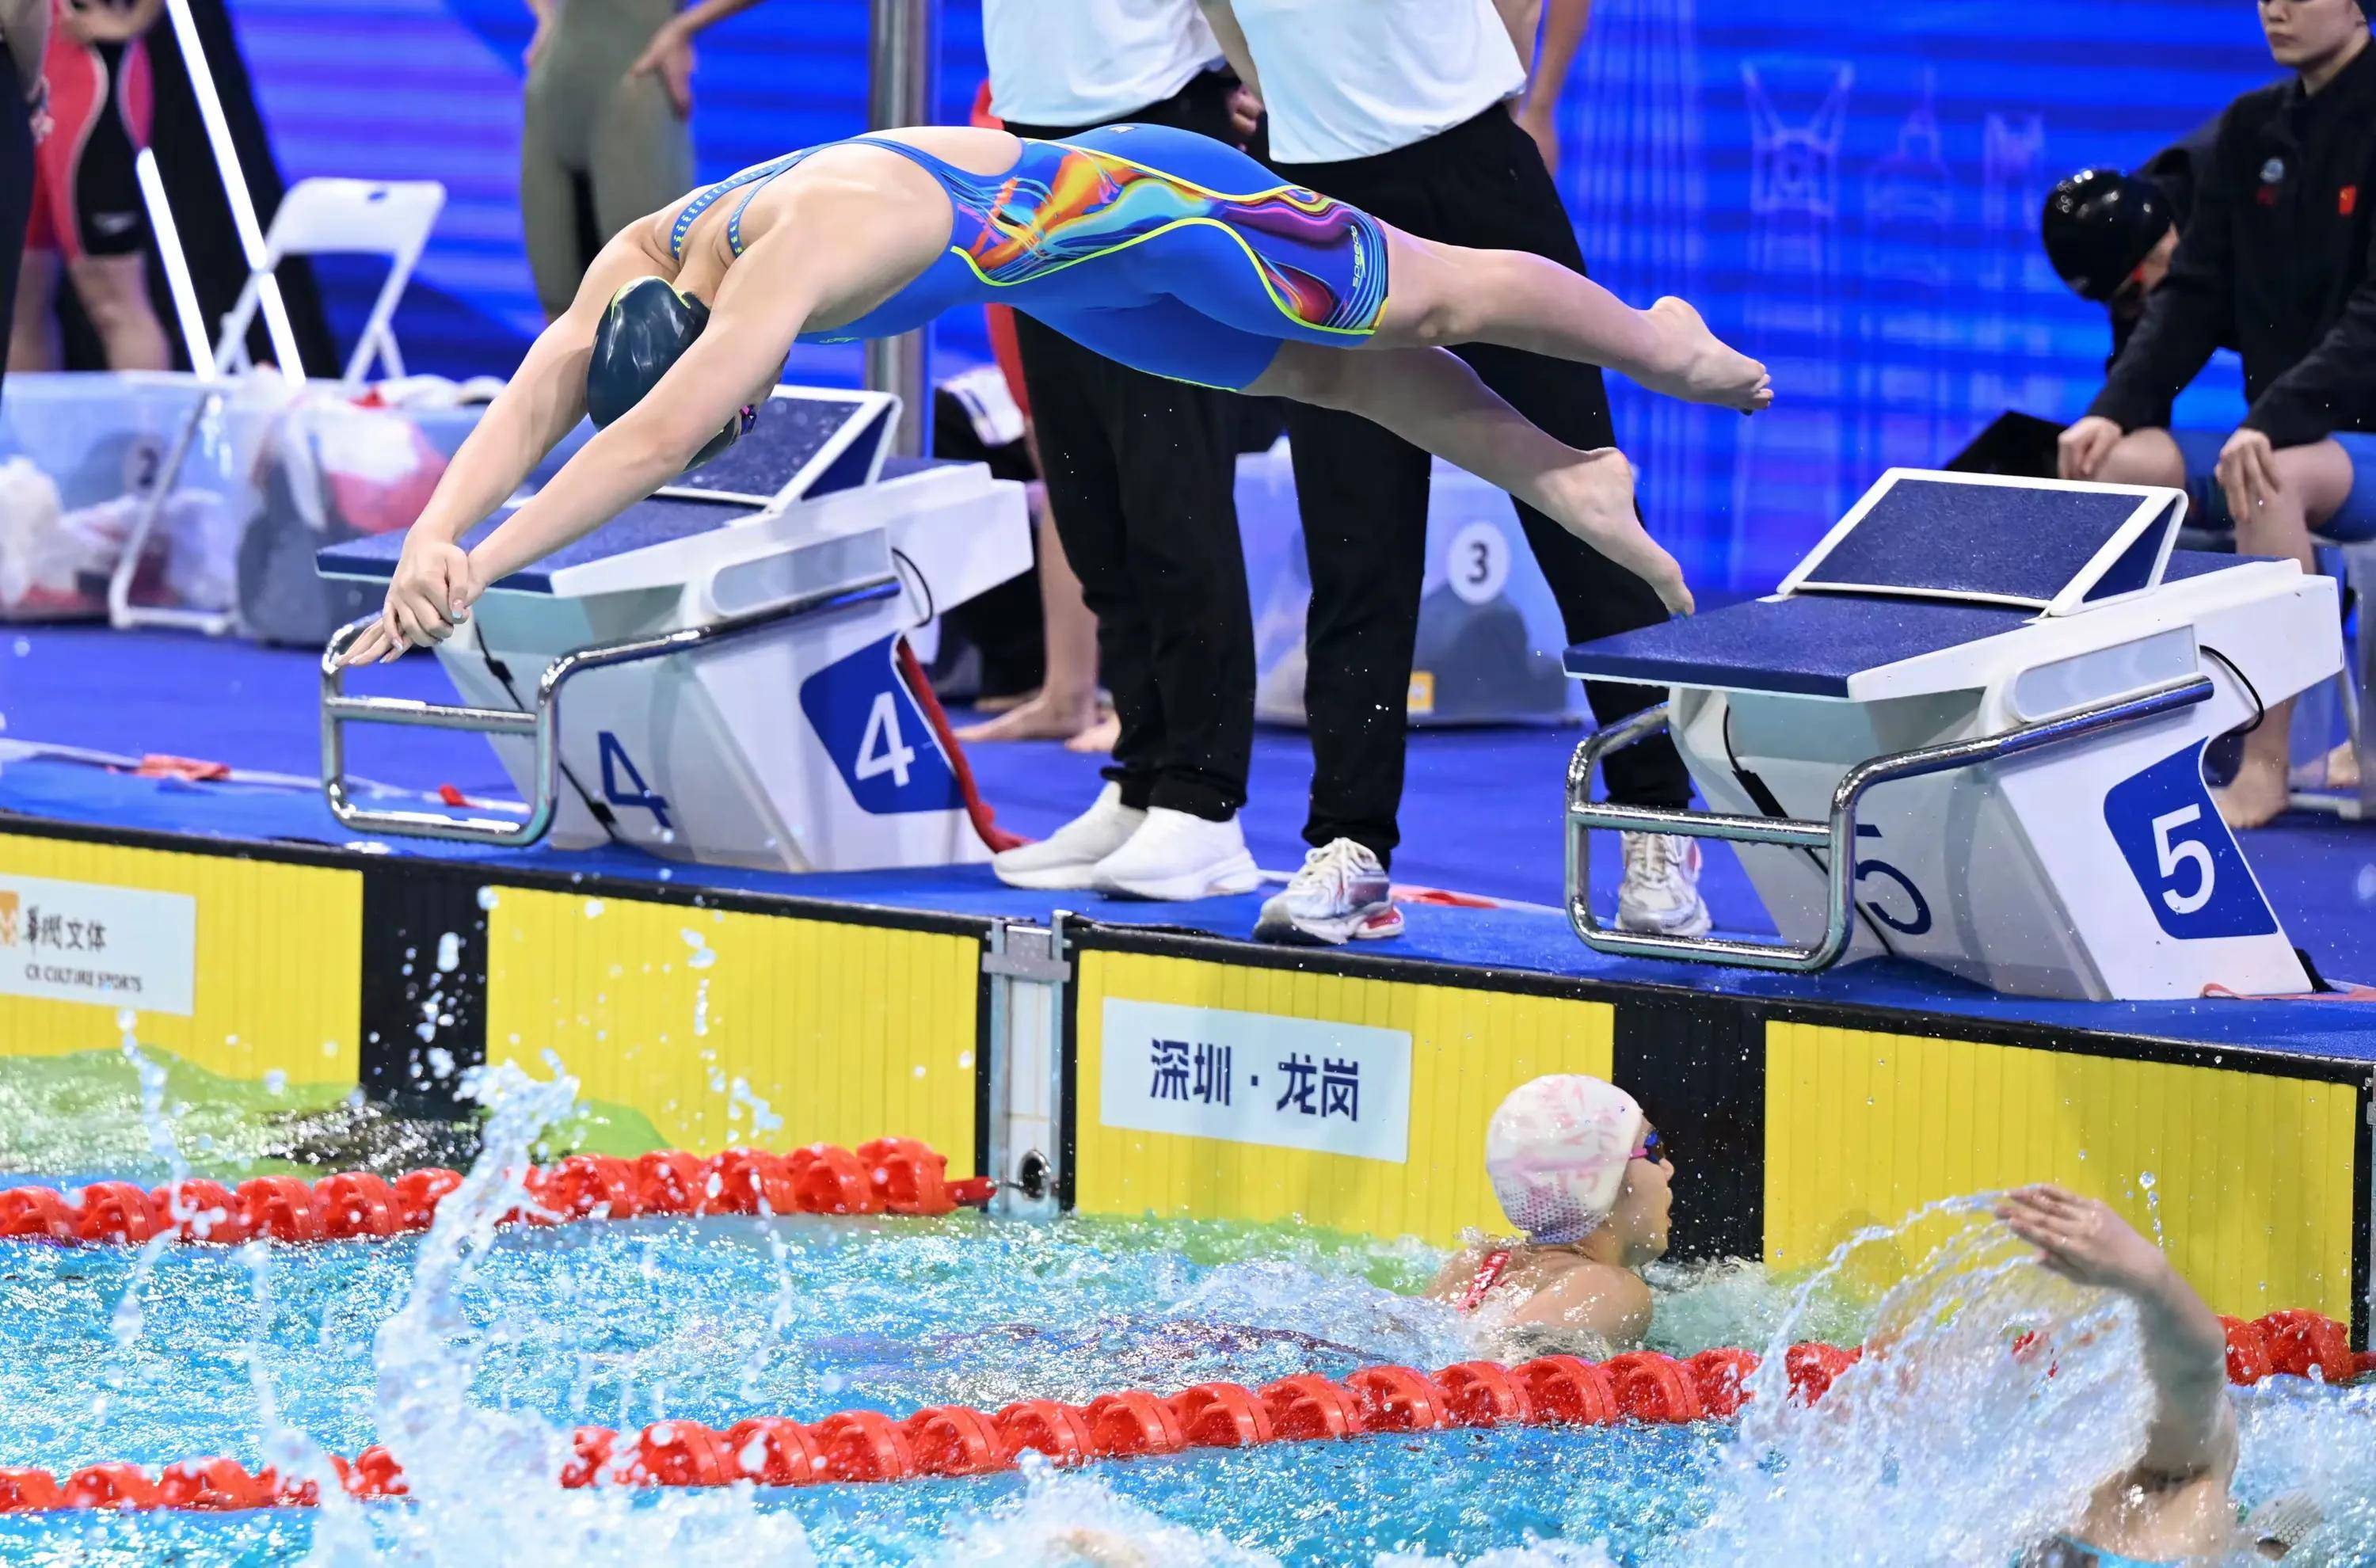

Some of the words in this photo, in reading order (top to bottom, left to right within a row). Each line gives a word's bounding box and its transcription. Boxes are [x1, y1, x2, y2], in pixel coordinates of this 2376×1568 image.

[1350, 225, 1361, 288] speedo
[1468, 541, 1488, 585] 3
[598, 730, 672, 829] 4
[855, 691, 916, 787] 4
[1855, 823, 1932, 935] 5
[2152, 802, 2215, 915] 5
